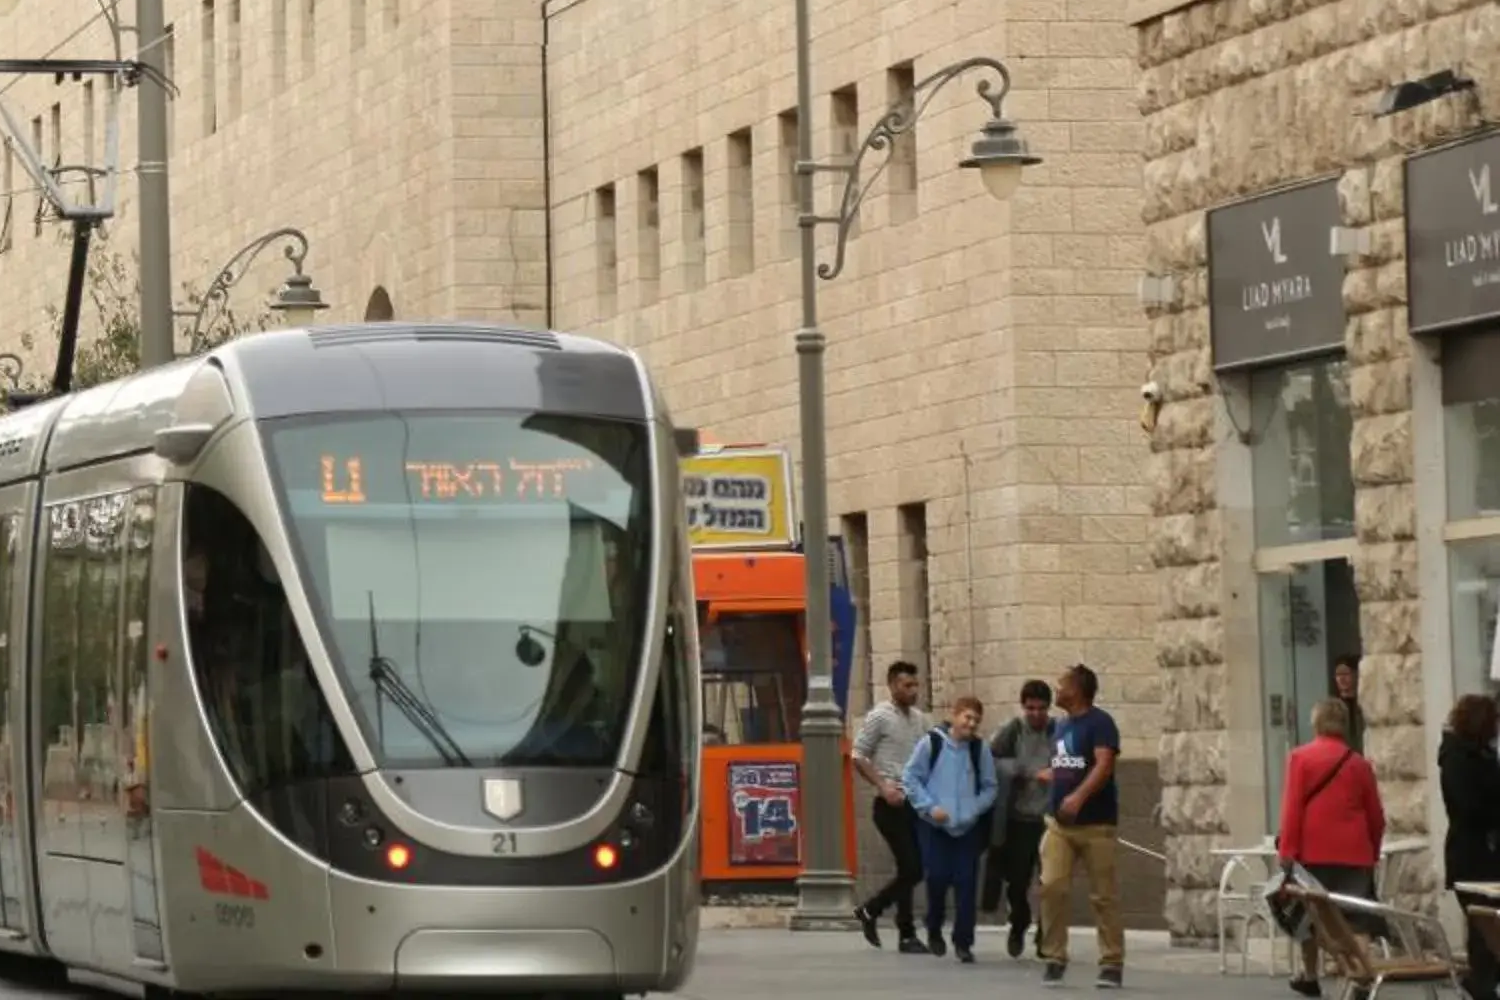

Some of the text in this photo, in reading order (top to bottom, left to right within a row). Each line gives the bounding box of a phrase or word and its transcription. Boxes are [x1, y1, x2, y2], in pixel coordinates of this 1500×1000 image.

[1445, 234, 1478, 267] LIAD
[1242, 282, 1270, 311] LIAD
[491, 832, 518, 853] 21
